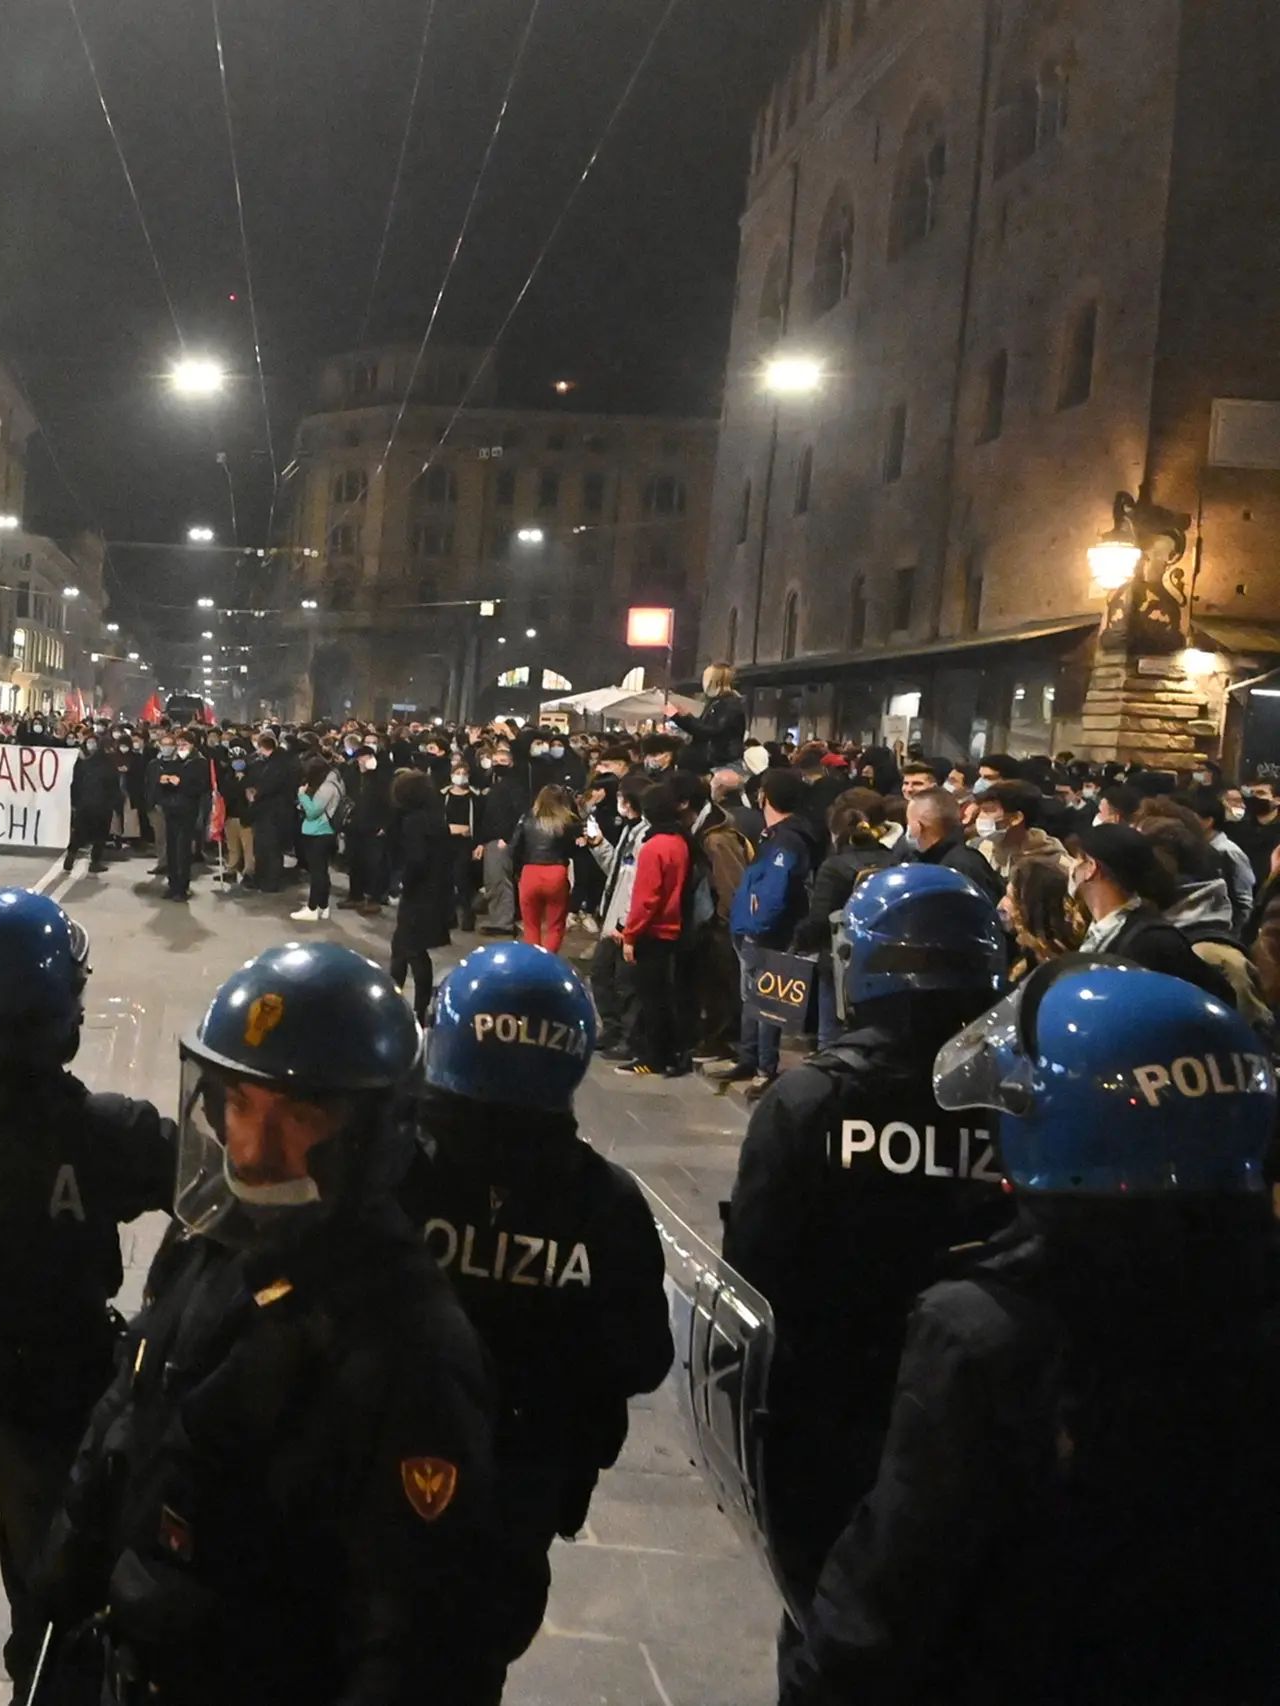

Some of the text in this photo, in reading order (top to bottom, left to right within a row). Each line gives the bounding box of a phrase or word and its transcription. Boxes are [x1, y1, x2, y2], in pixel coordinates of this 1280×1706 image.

[757, 971, 806, 1003] OVS
[473, 1013, 588, 1060] POLIZIA
[841, 1119, 1004, 1183] POLIZ
[423, 1218, 591, 1288] OLIZIA
